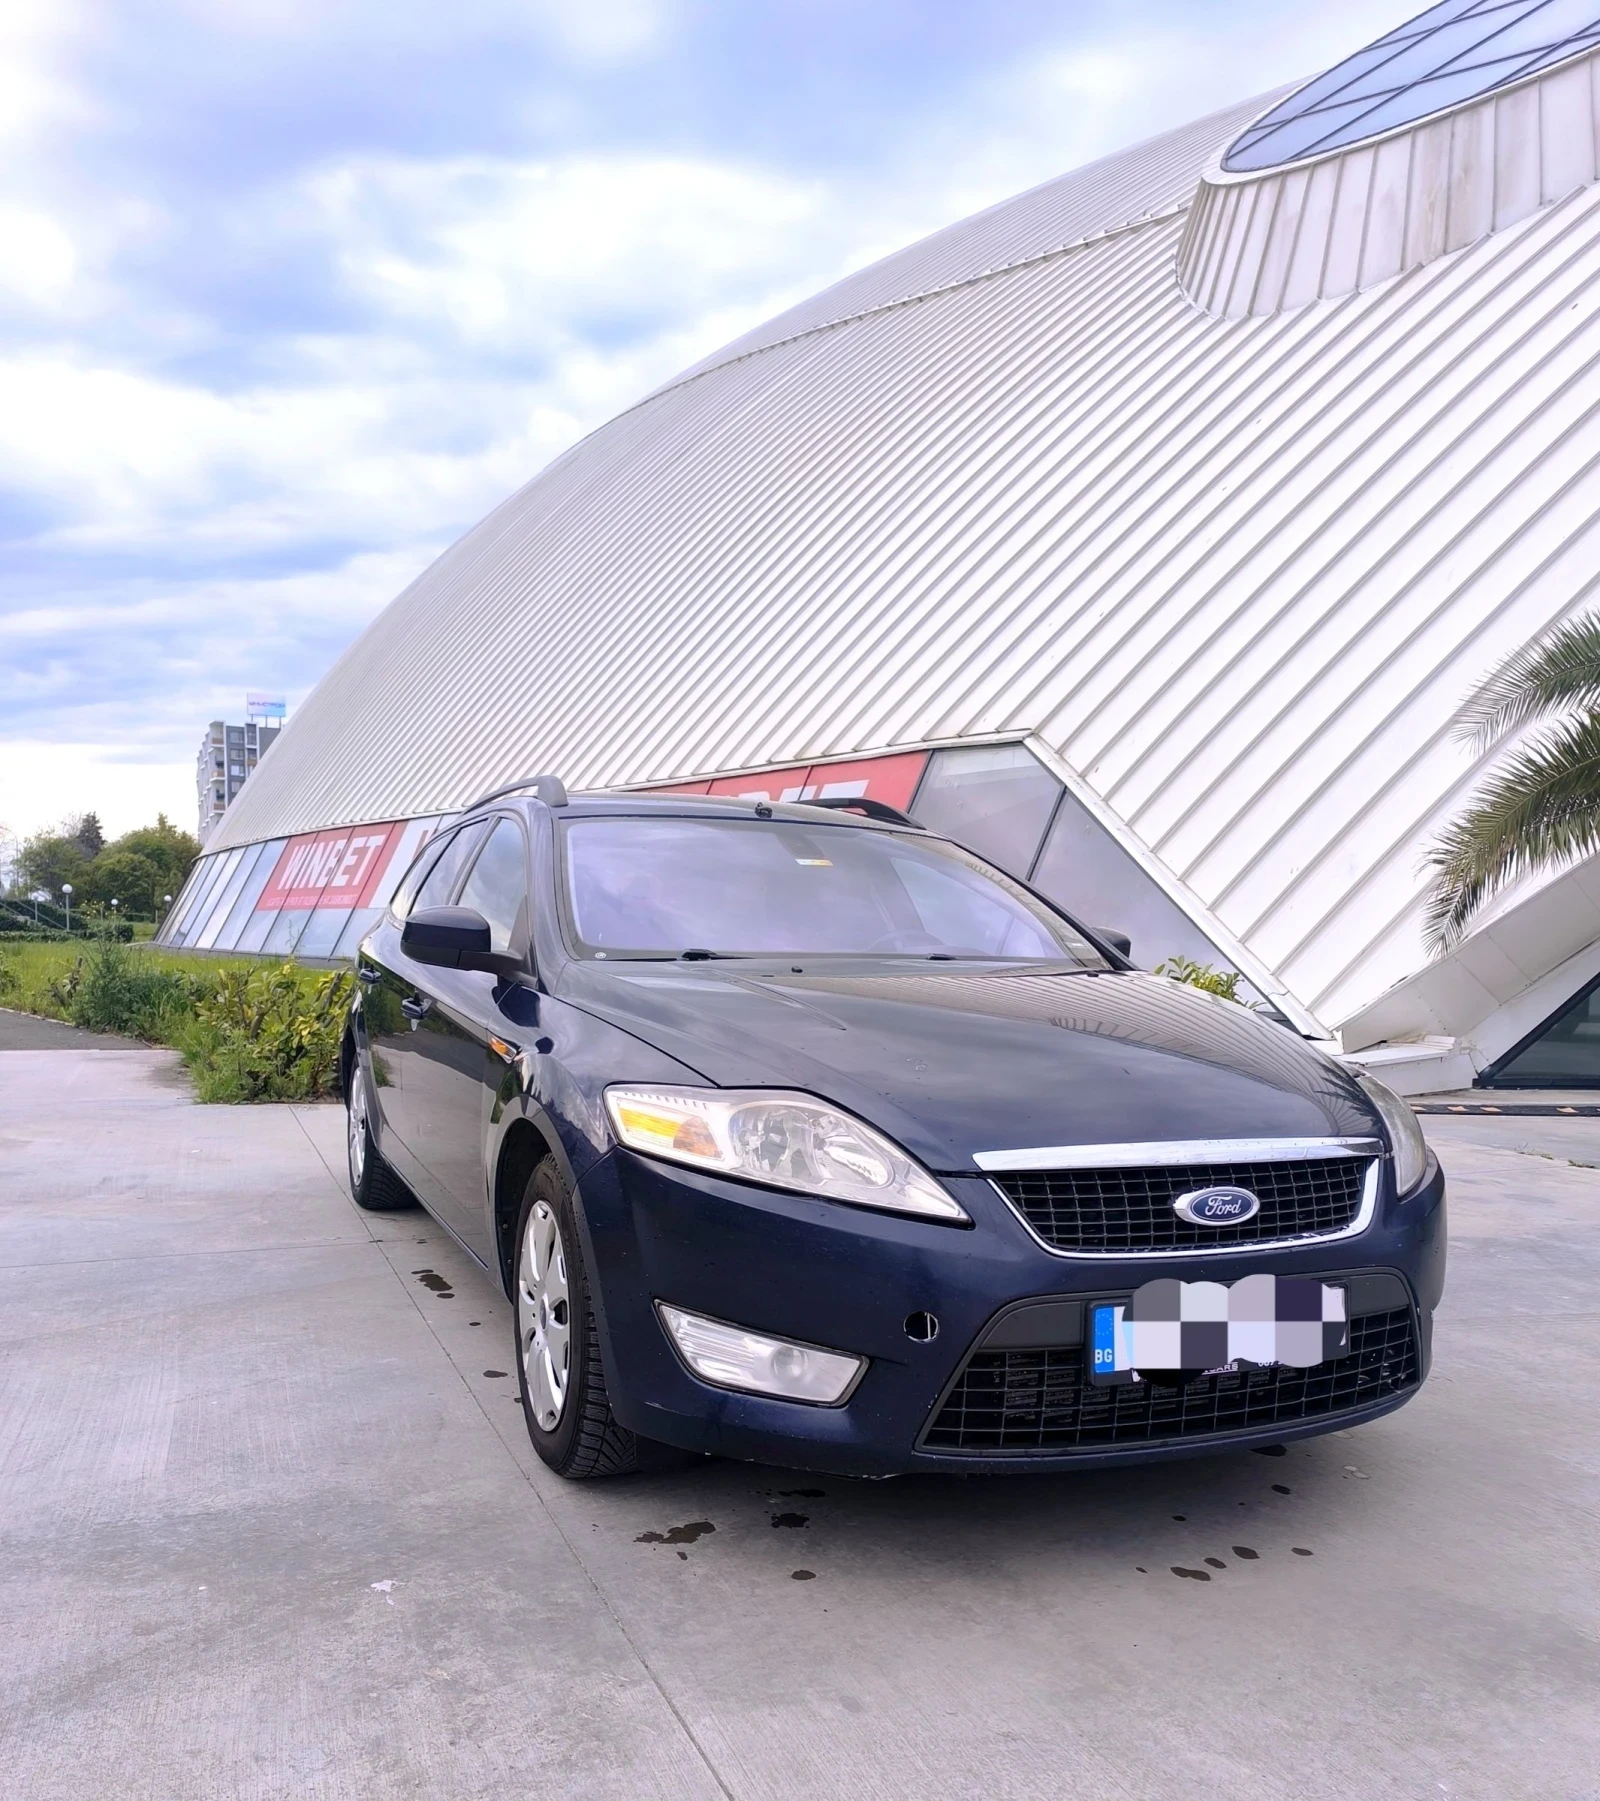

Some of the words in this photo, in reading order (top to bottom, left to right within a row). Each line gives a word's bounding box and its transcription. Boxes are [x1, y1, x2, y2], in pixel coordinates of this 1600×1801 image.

[277, 835, 387, 891] WINBET
[1205, 1195, 1242, 1216] Ford
[1095, 1348, 1113, 1364] BG
